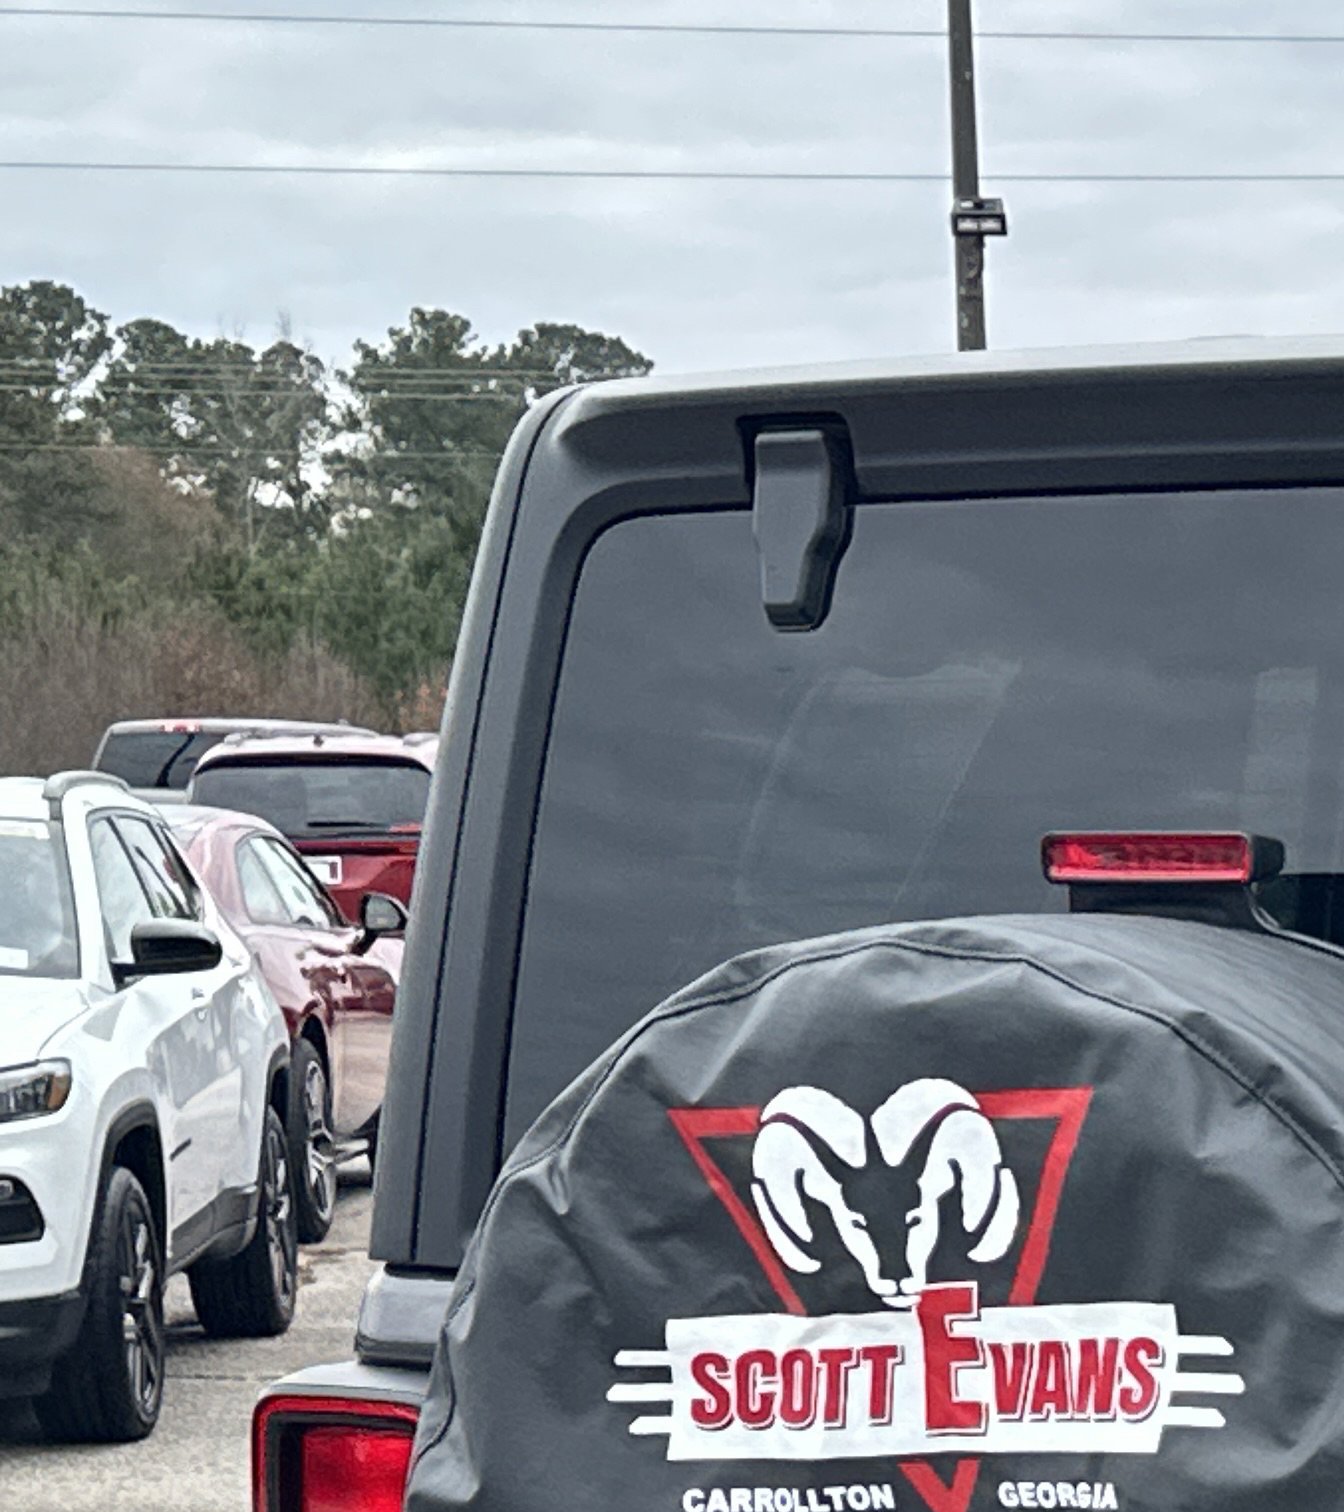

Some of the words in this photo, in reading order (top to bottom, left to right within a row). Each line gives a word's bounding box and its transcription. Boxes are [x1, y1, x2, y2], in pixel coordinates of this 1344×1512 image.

[690, 1345, 899, 1432] SCOTT
[915, 1281, 1163, 1436] EVANS
[997, 1481, 1119, 1511] GEORGIA
